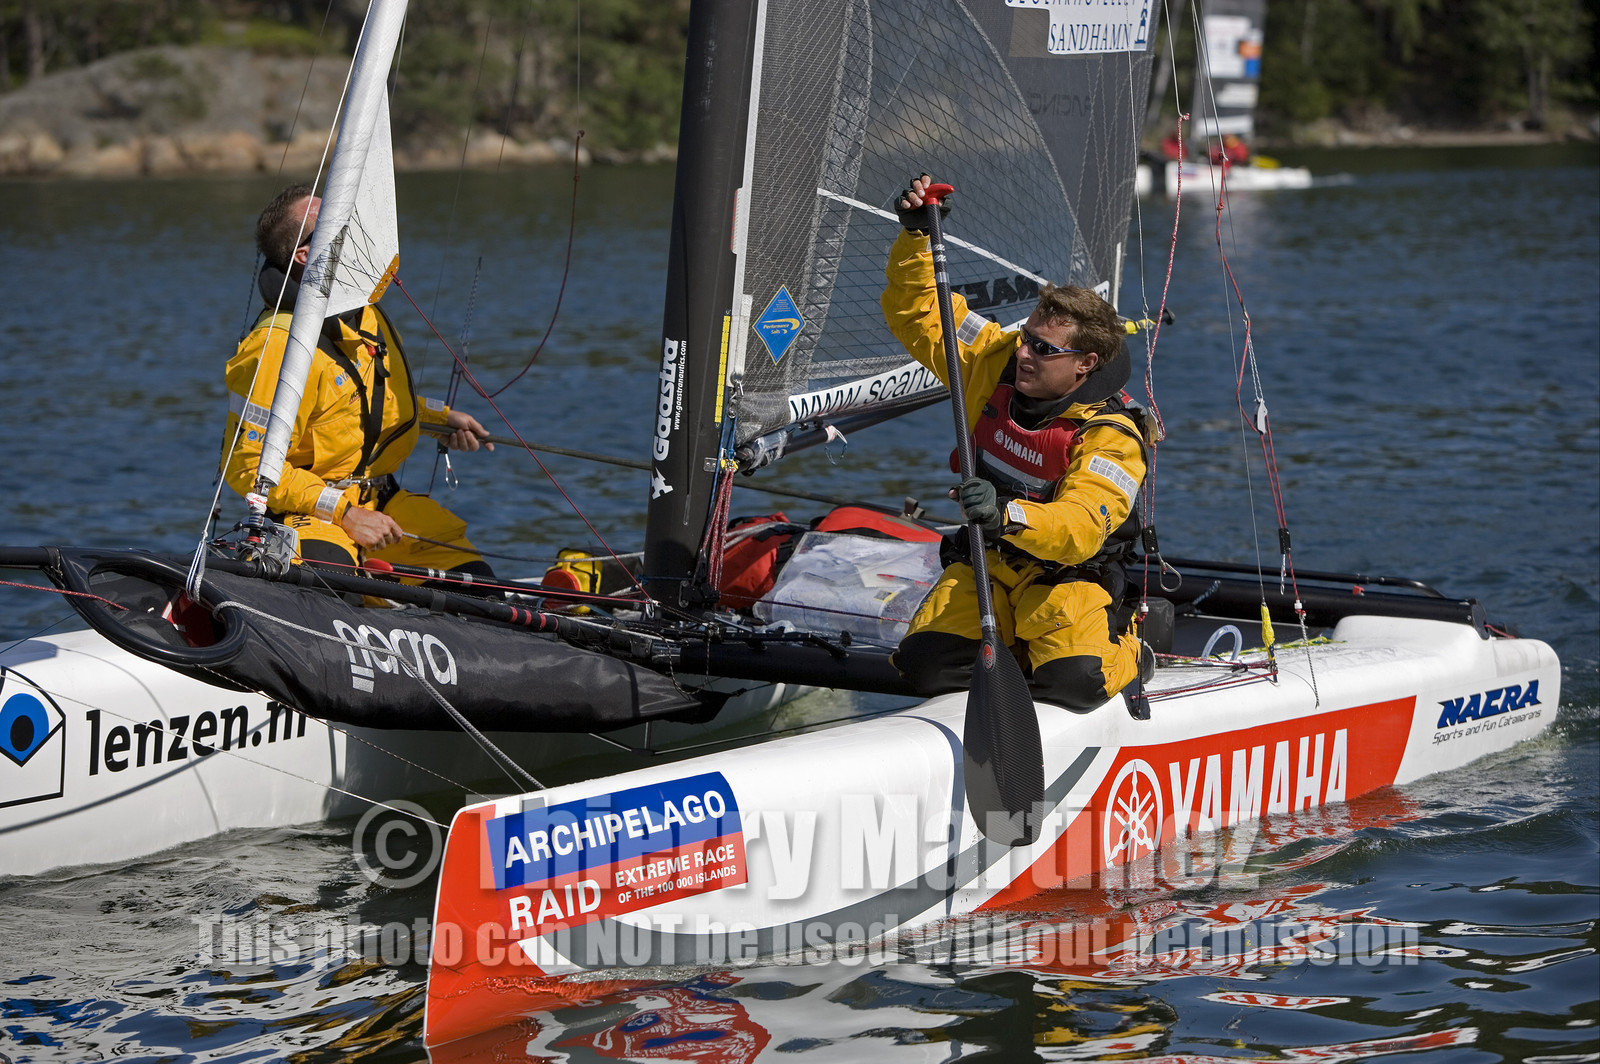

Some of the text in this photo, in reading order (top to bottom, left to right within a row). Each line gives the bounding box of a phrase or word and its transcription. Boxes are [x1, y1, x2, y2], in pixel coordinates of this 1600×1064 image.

[1048, 23, 1133, 51] SANDHAMN
[653, 337, 679, 462] Gaastra
[1003, 434, 1044, 467] YAMAHA
[1432, 709, 1542, 746] Sports and Fun Catamarans
[1437, 679, 1542, 729] NACRA
[1168, 728, 1348, 833] YAMAHA
[505, 789, 726, 869] ARCHIPELAGO
[615, 844, 736, 888] EXTREME RACE
[618, 865, 737, 904] OF THE 100 000 ISLANDS
[509, 879, 601, 931] RAID
